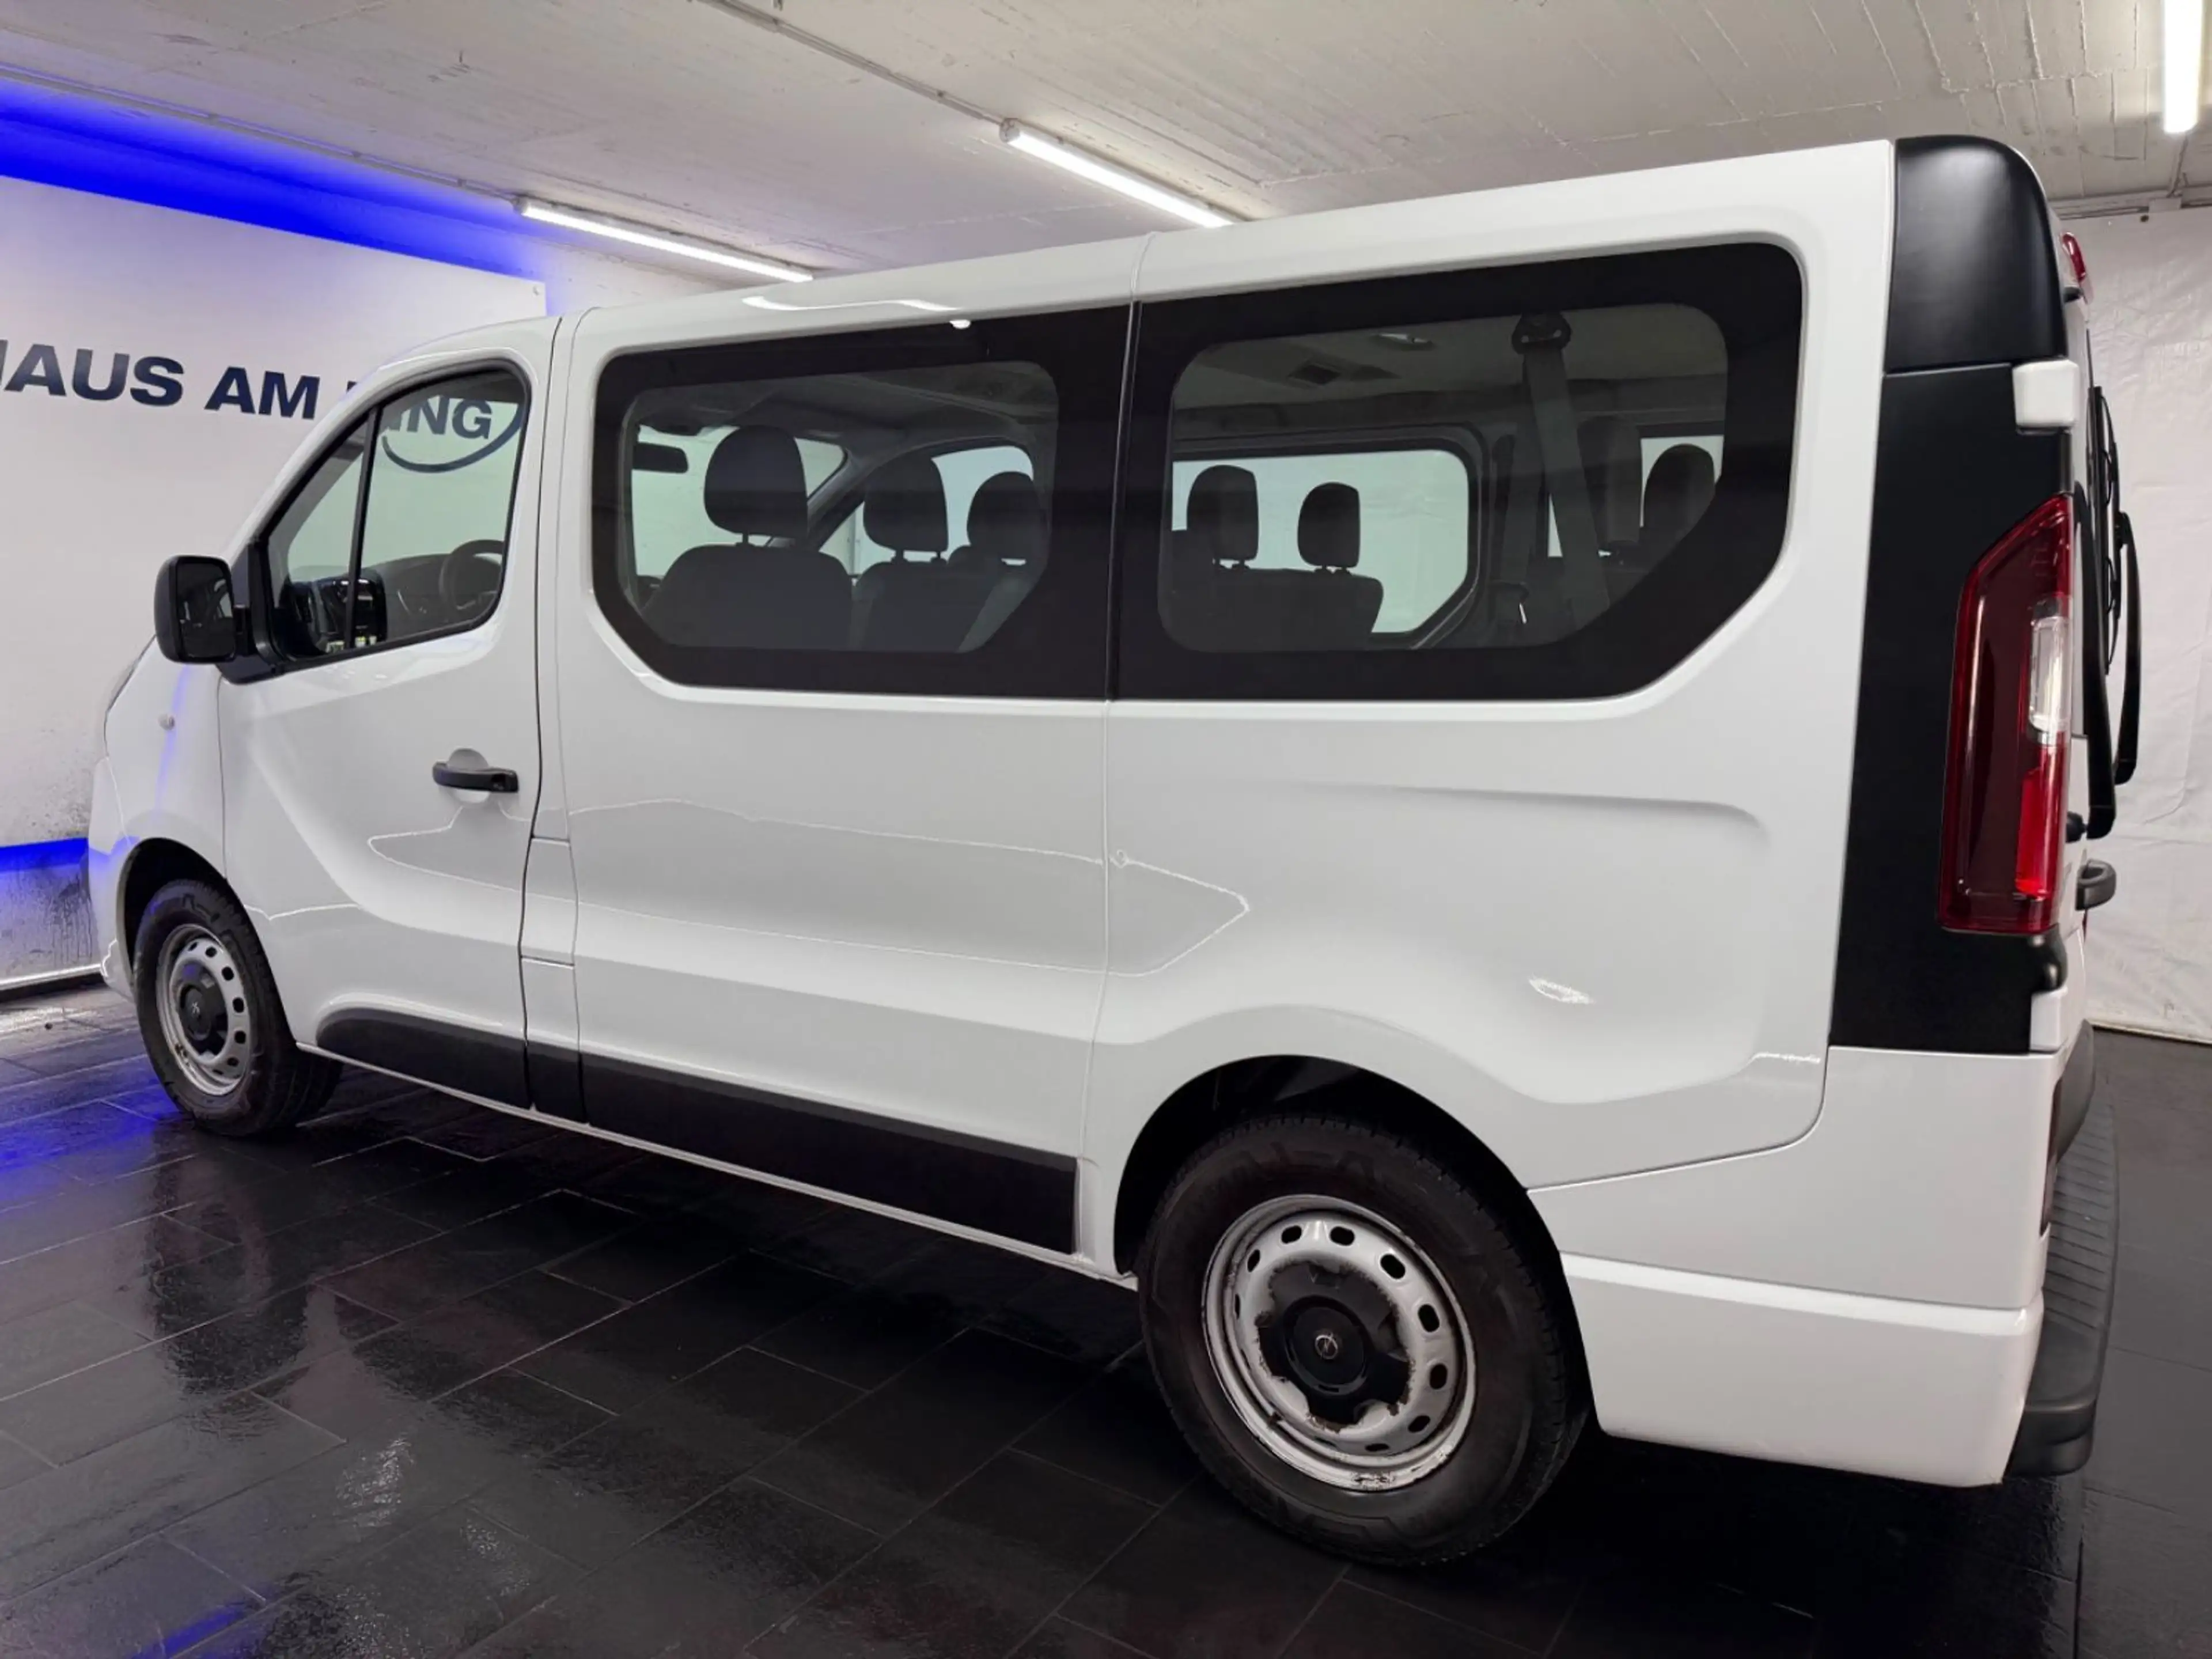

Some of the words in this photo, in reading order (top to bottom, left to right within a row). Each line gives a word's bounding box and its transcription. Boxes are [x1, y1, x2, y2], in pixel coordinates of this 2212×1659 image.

[0, 339, 184, 407] AUS
[204, 366, 320, 420] AM
[346, 380, 493, 440] NG
